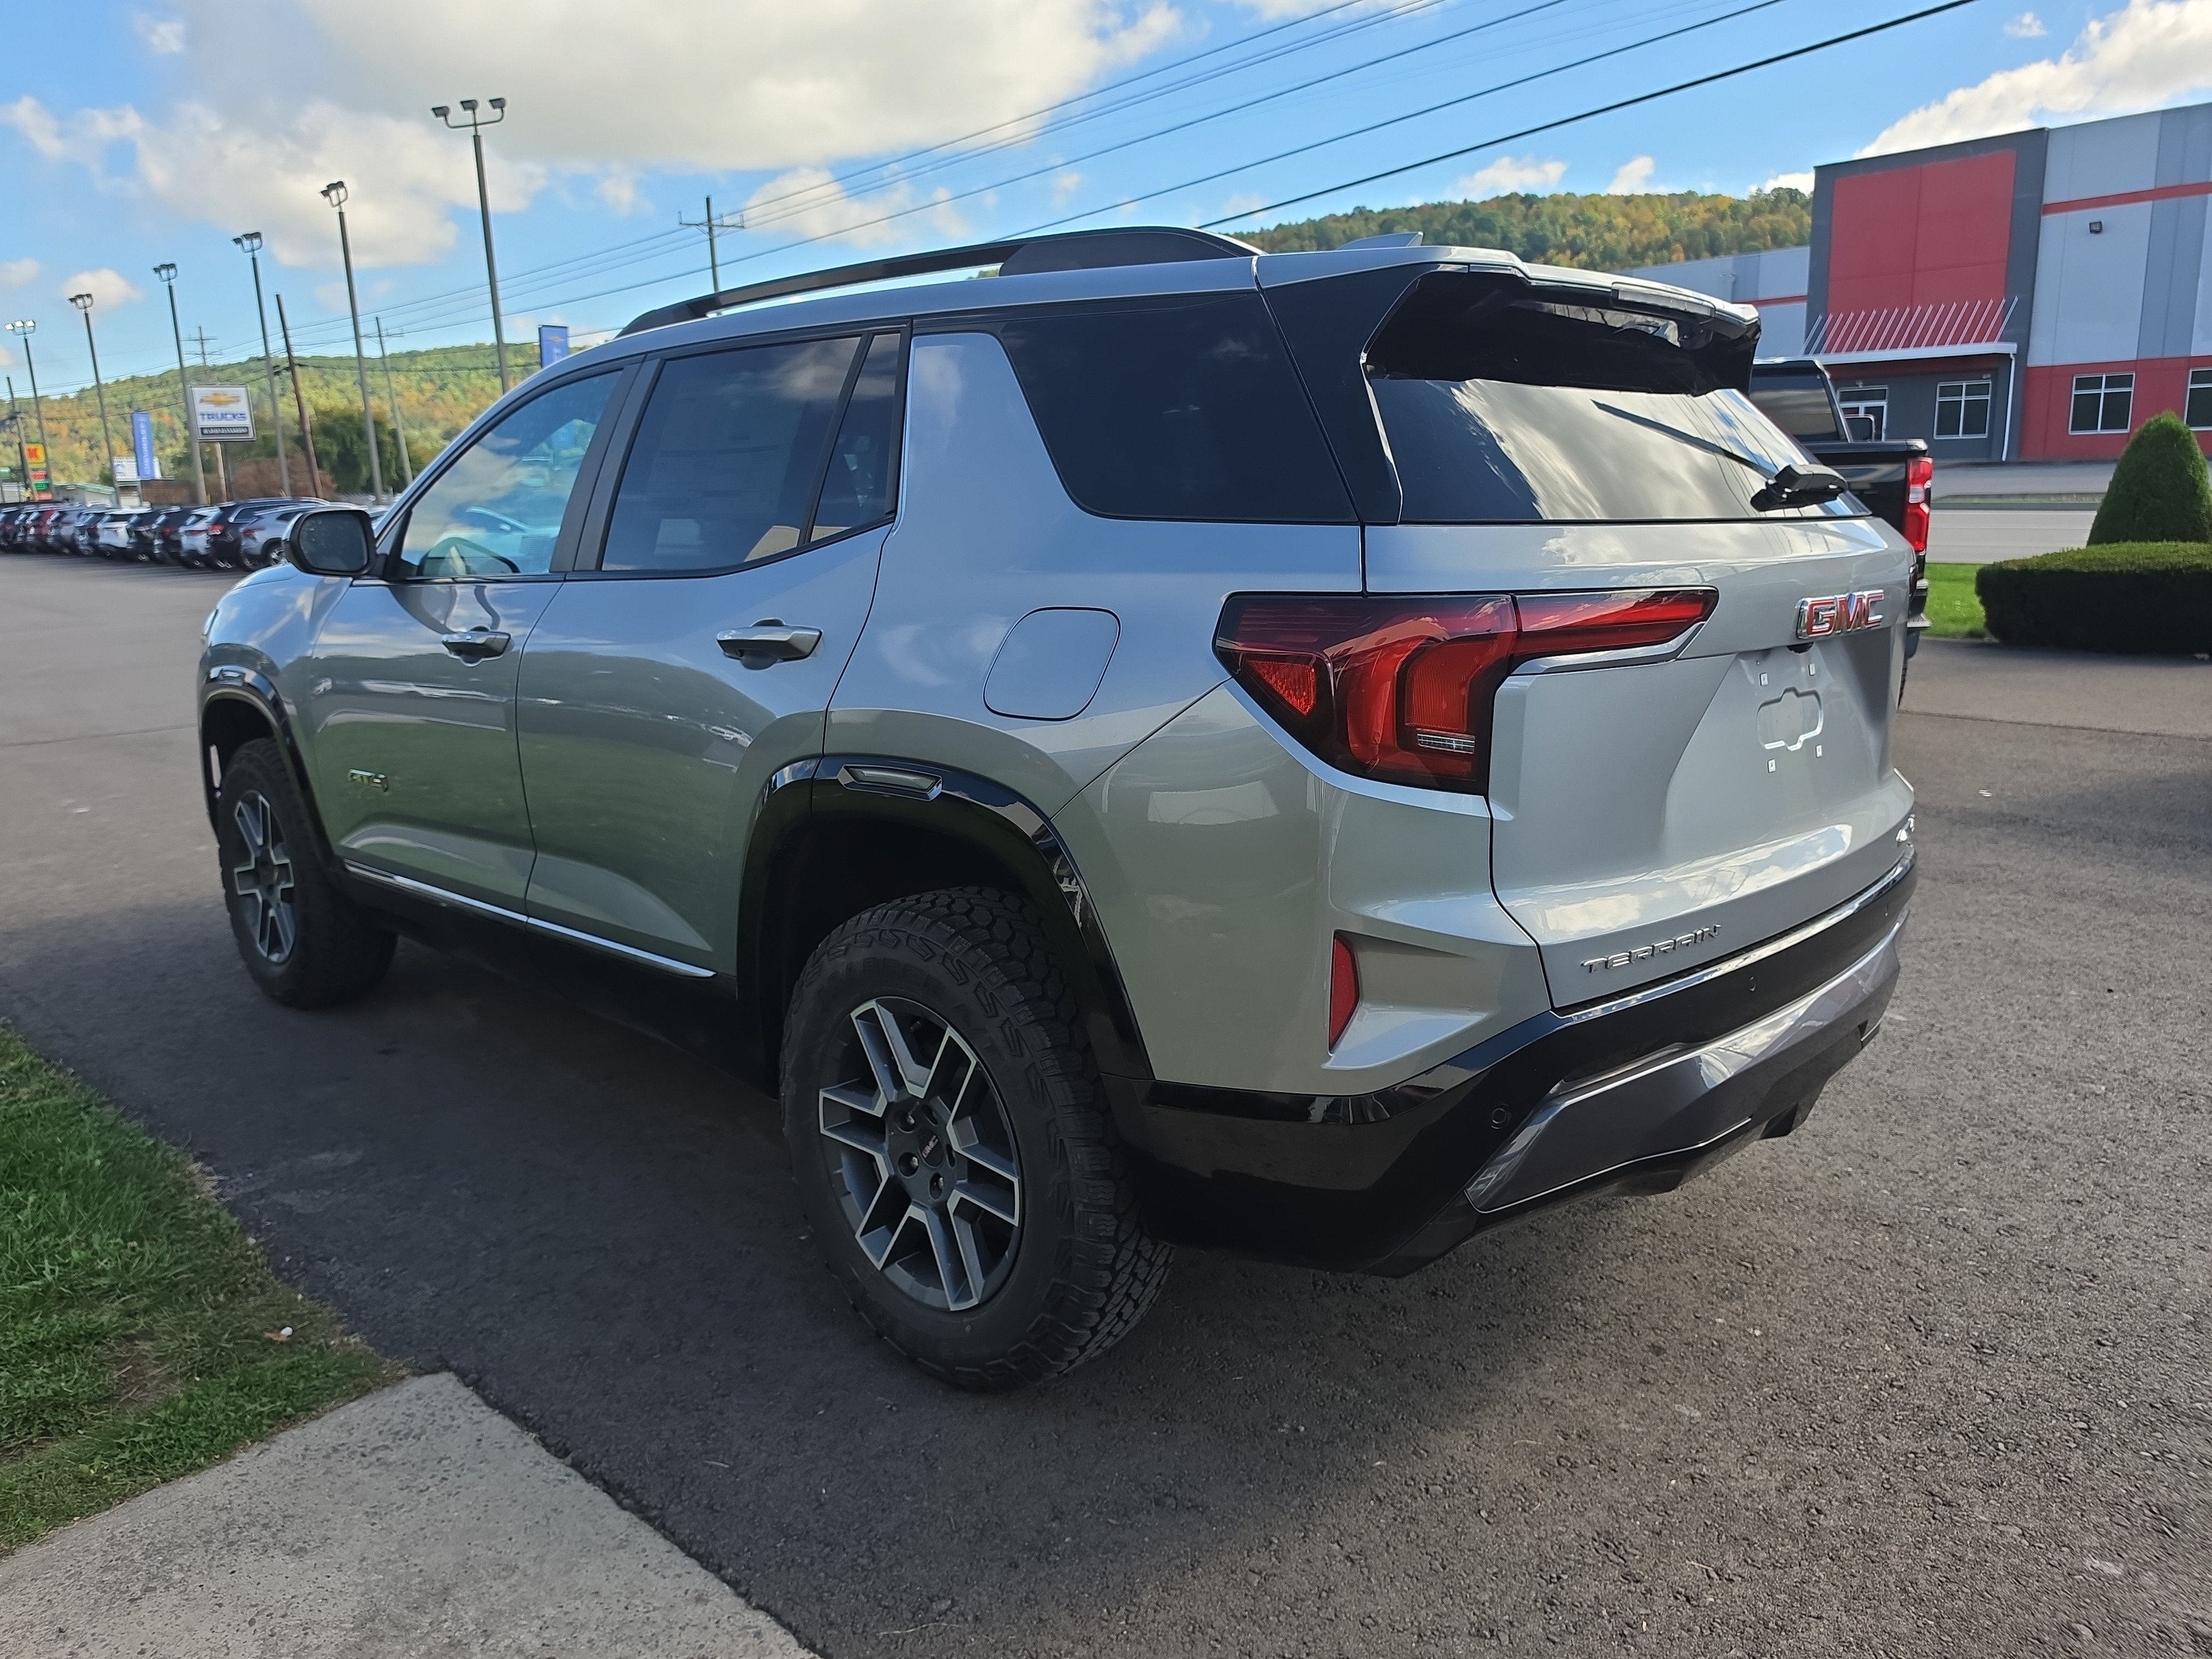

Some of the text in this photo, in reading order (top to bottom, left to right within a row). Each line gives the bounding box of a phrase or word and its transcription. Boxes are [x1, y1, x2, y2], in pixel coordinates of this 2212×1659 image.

[199, 413, 247, 422] TRUCKS
[1795, 589, 1884, 639] GMC
[1581, 924, 1721, 973] TERRAIN
[922, 1135, 938, 1158] GMC
